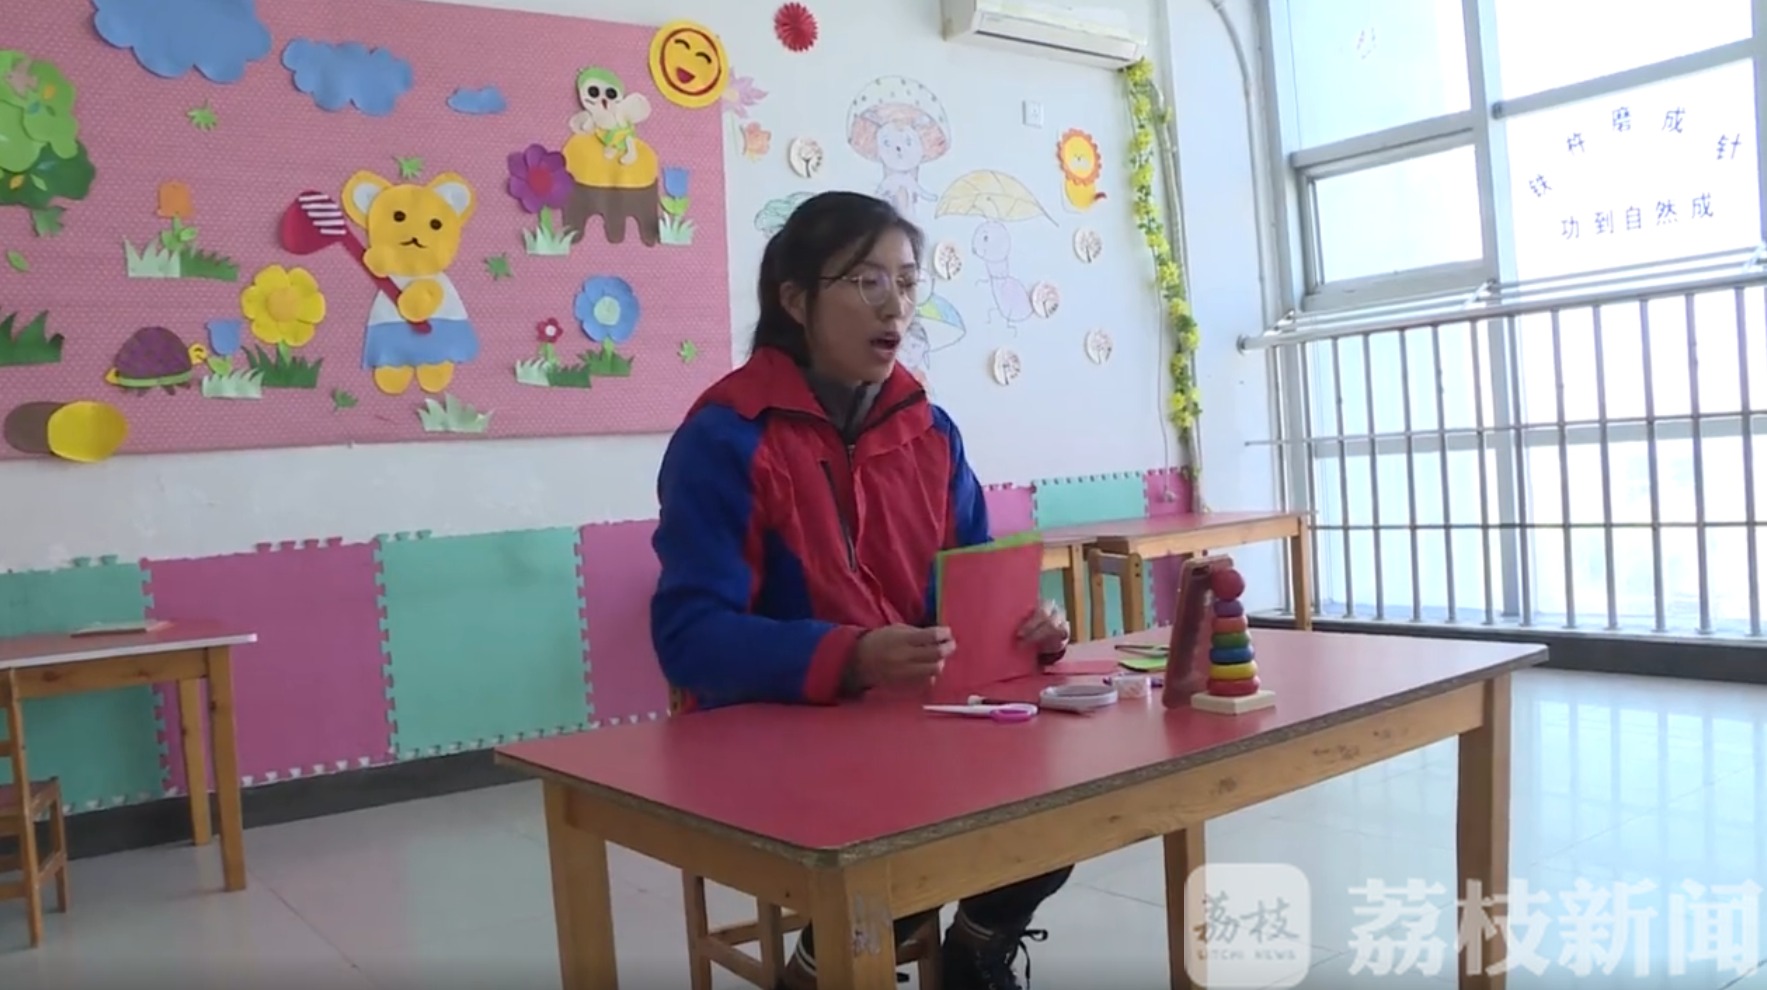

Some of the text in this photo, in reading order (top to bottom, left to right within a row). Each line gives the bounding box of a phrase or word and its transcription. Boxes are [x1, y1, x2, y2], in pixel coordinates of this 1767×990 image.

[1529, 106, 1742, 197] 铁杵磨成针
[1561, 193, 1714, 240] 功到自然成
